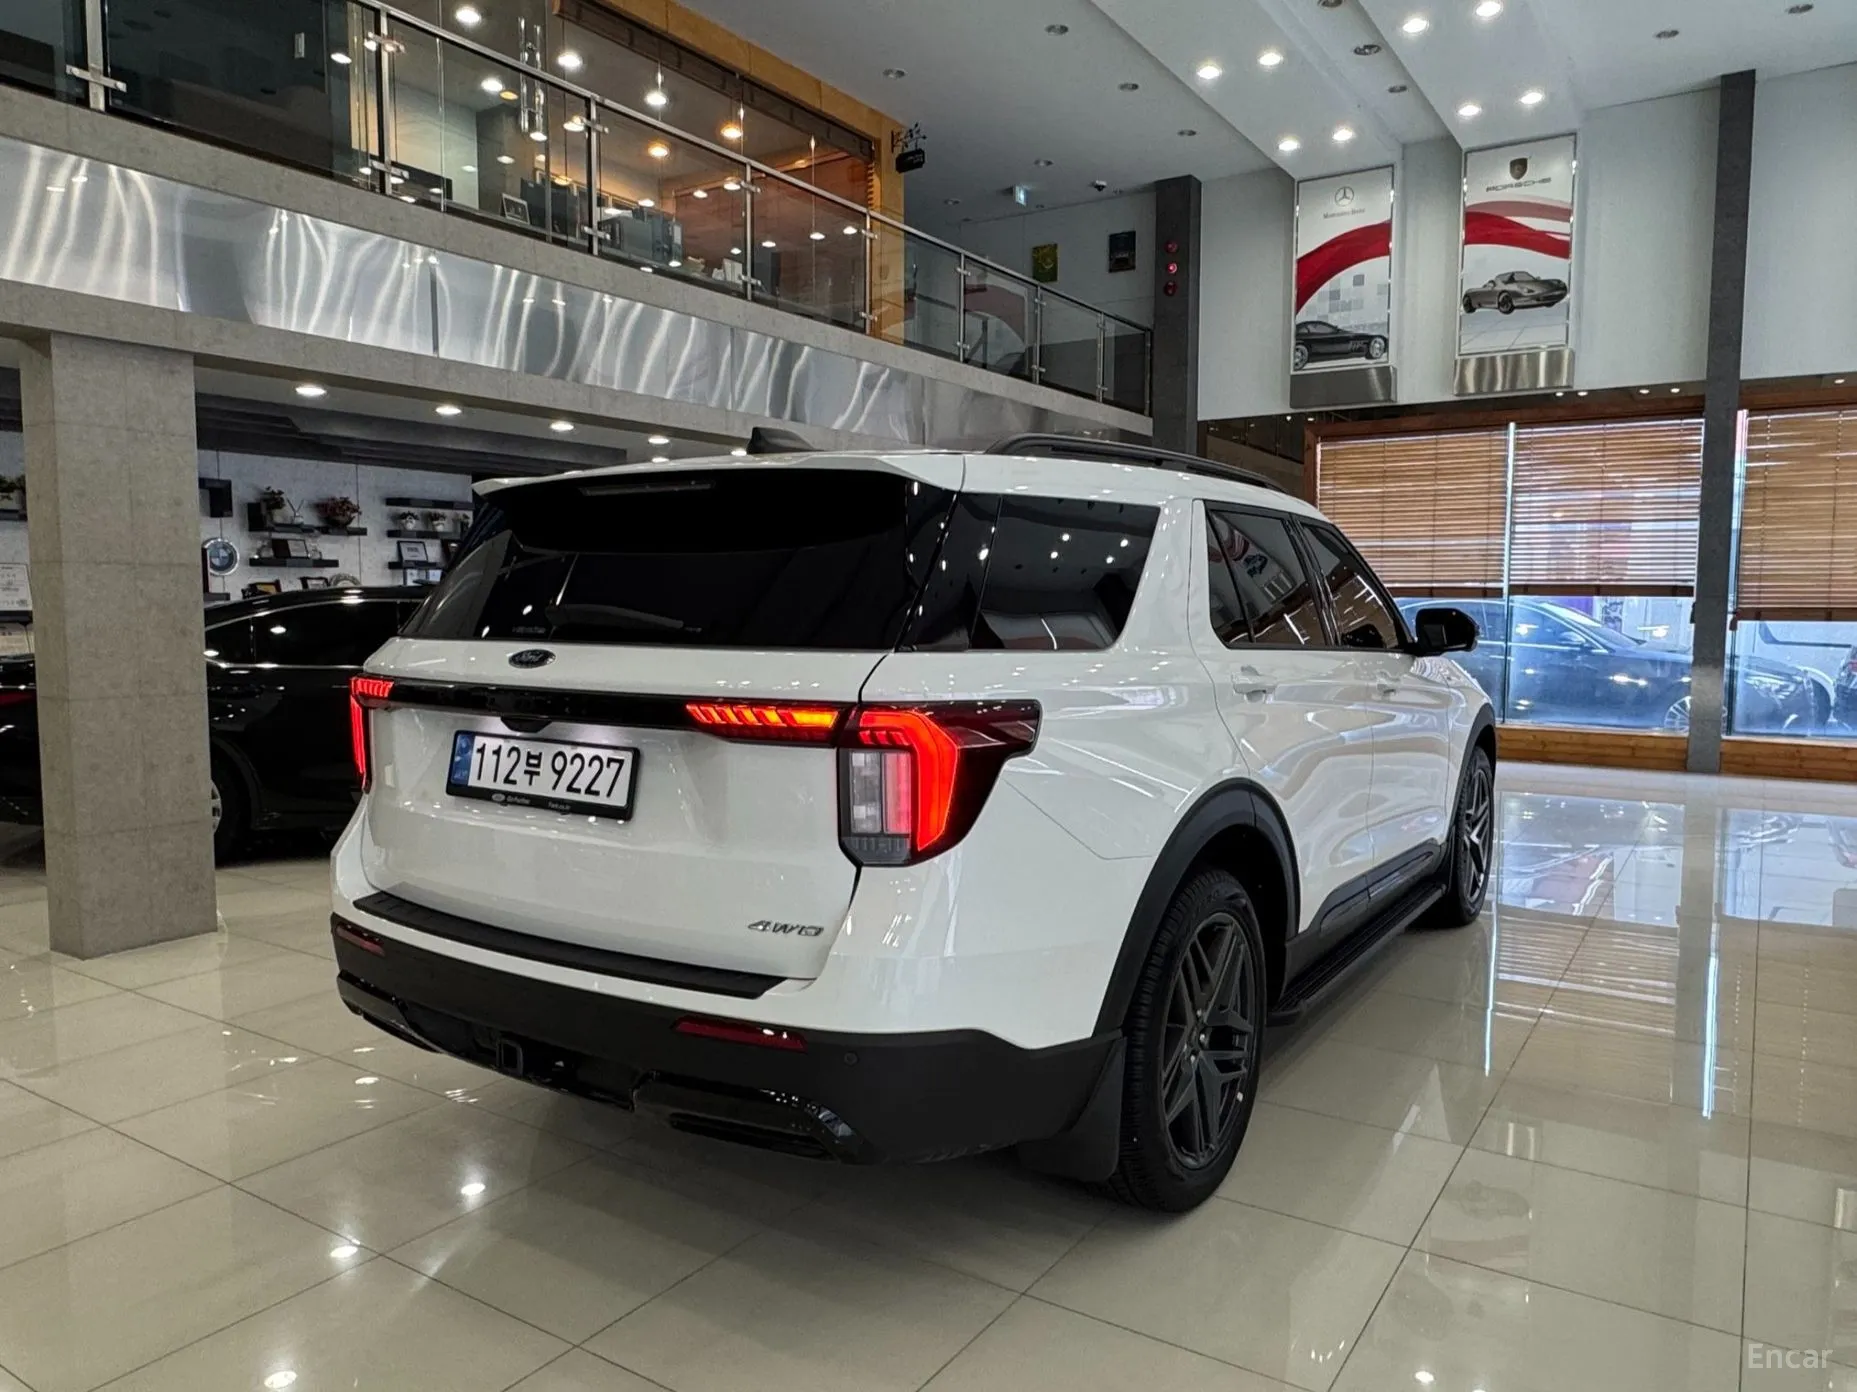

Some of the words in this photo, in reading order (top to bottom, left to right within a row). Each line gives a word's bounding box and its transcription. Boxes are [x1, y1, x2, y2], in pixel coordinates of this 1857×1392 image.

[1486, 177, 1551, 192] PORSCHE
[476, 742, 543, 786] 112부
[551, 751, 625, 798] 9227
[748, 920, 824, 936] 4WD
